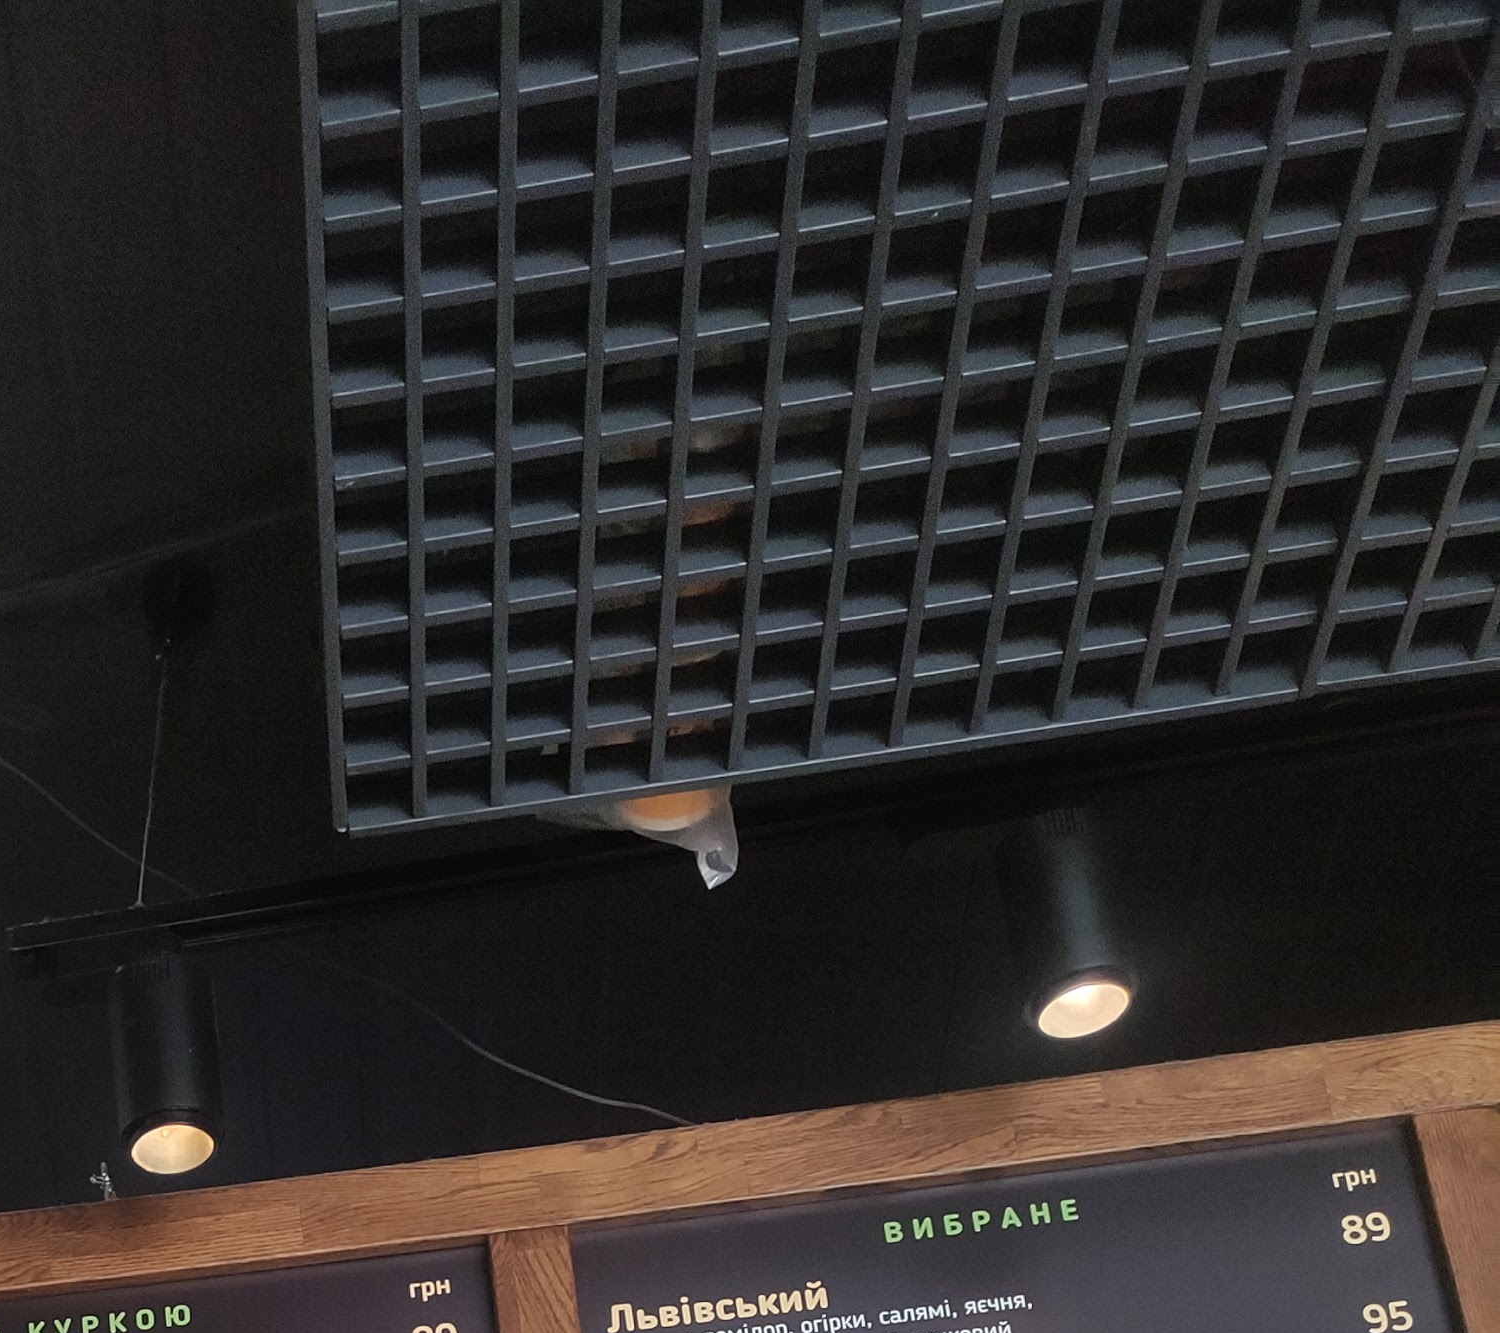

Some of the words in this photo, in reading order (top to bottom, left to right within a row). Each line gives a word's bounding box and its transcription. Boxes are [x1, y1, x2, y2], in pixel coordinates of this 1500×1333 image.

[1330, 1167, 1378, 1193] грн
[882, 1197, 1080, 1245] ВИБРАНЕ
[1340, 1210, 1392, 1246] 89
[408, 1278, 452, 1303] грн
